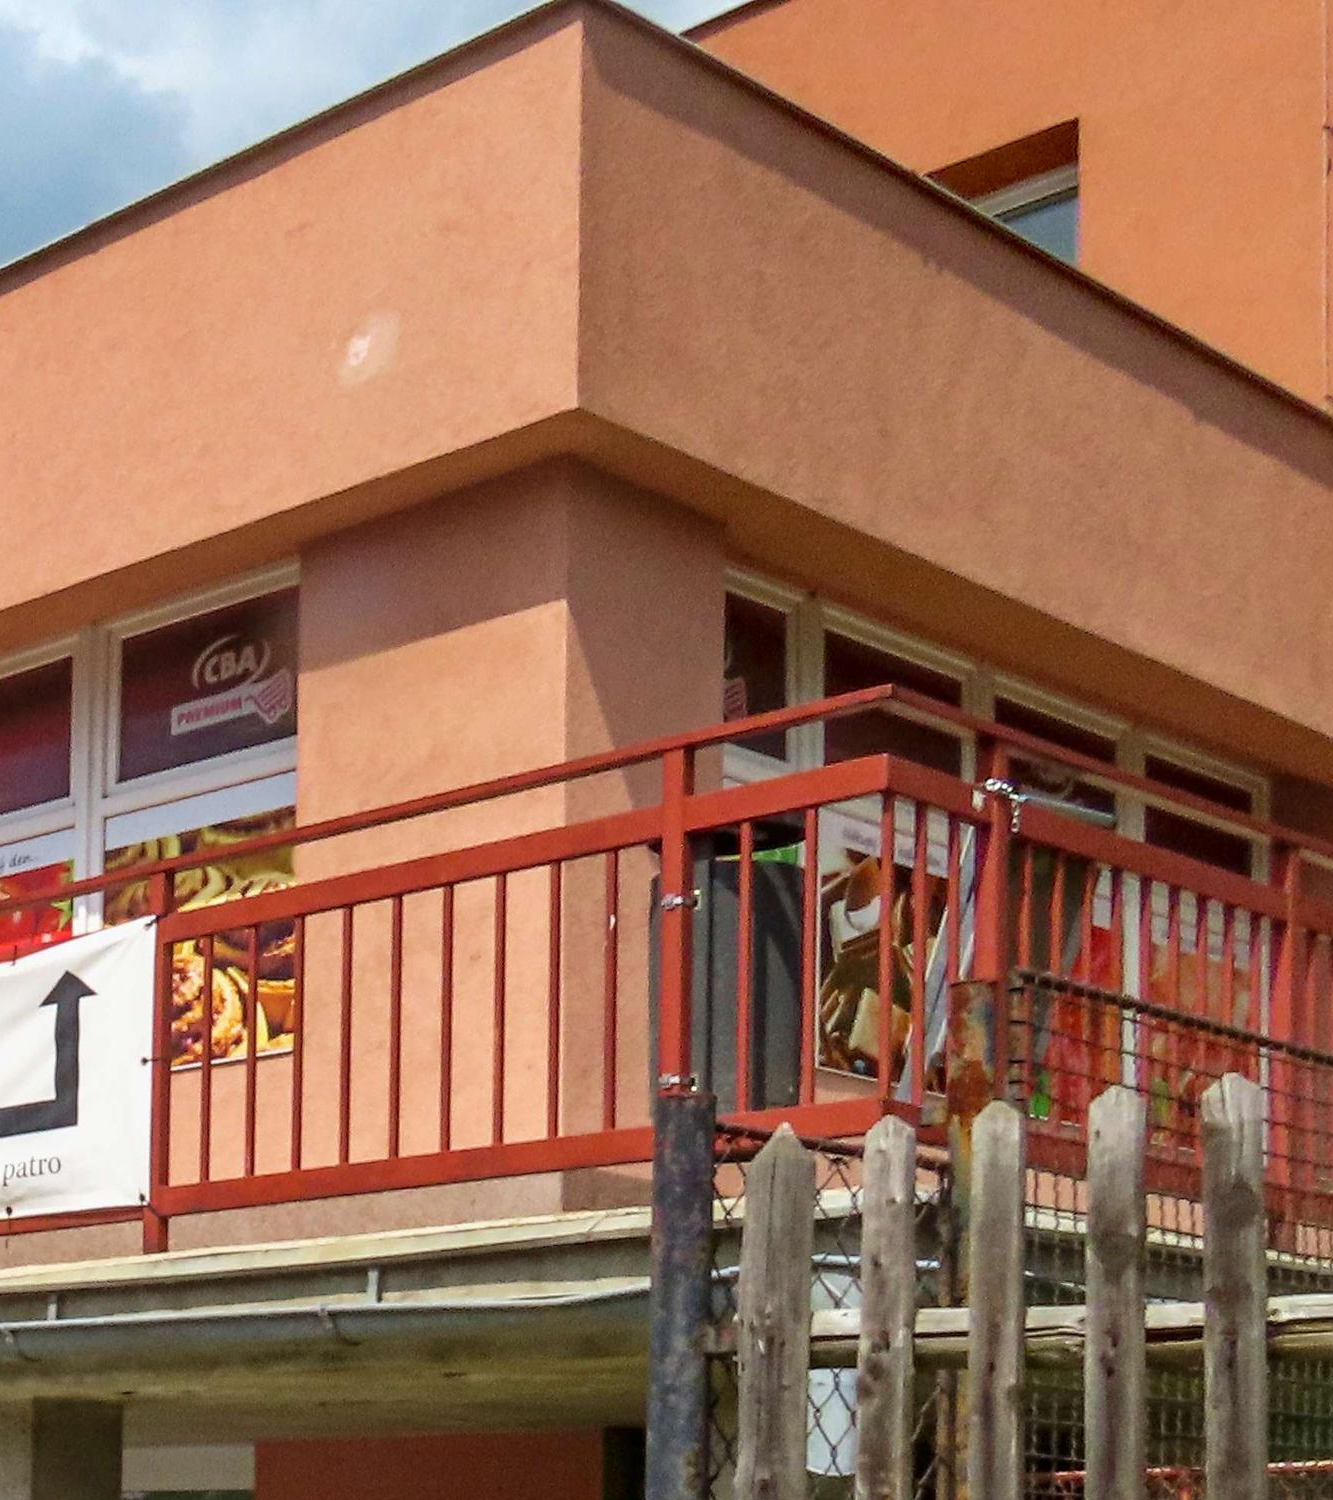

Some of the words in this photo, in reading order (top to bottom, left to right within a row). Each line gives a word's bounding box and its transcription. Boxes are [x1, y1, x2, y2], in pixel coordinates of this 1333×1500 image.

[202, 642, 261, 685] CBA
[177, 697, 243, 726] PREMIUM
[2, 1156, 62, 1187] patro
